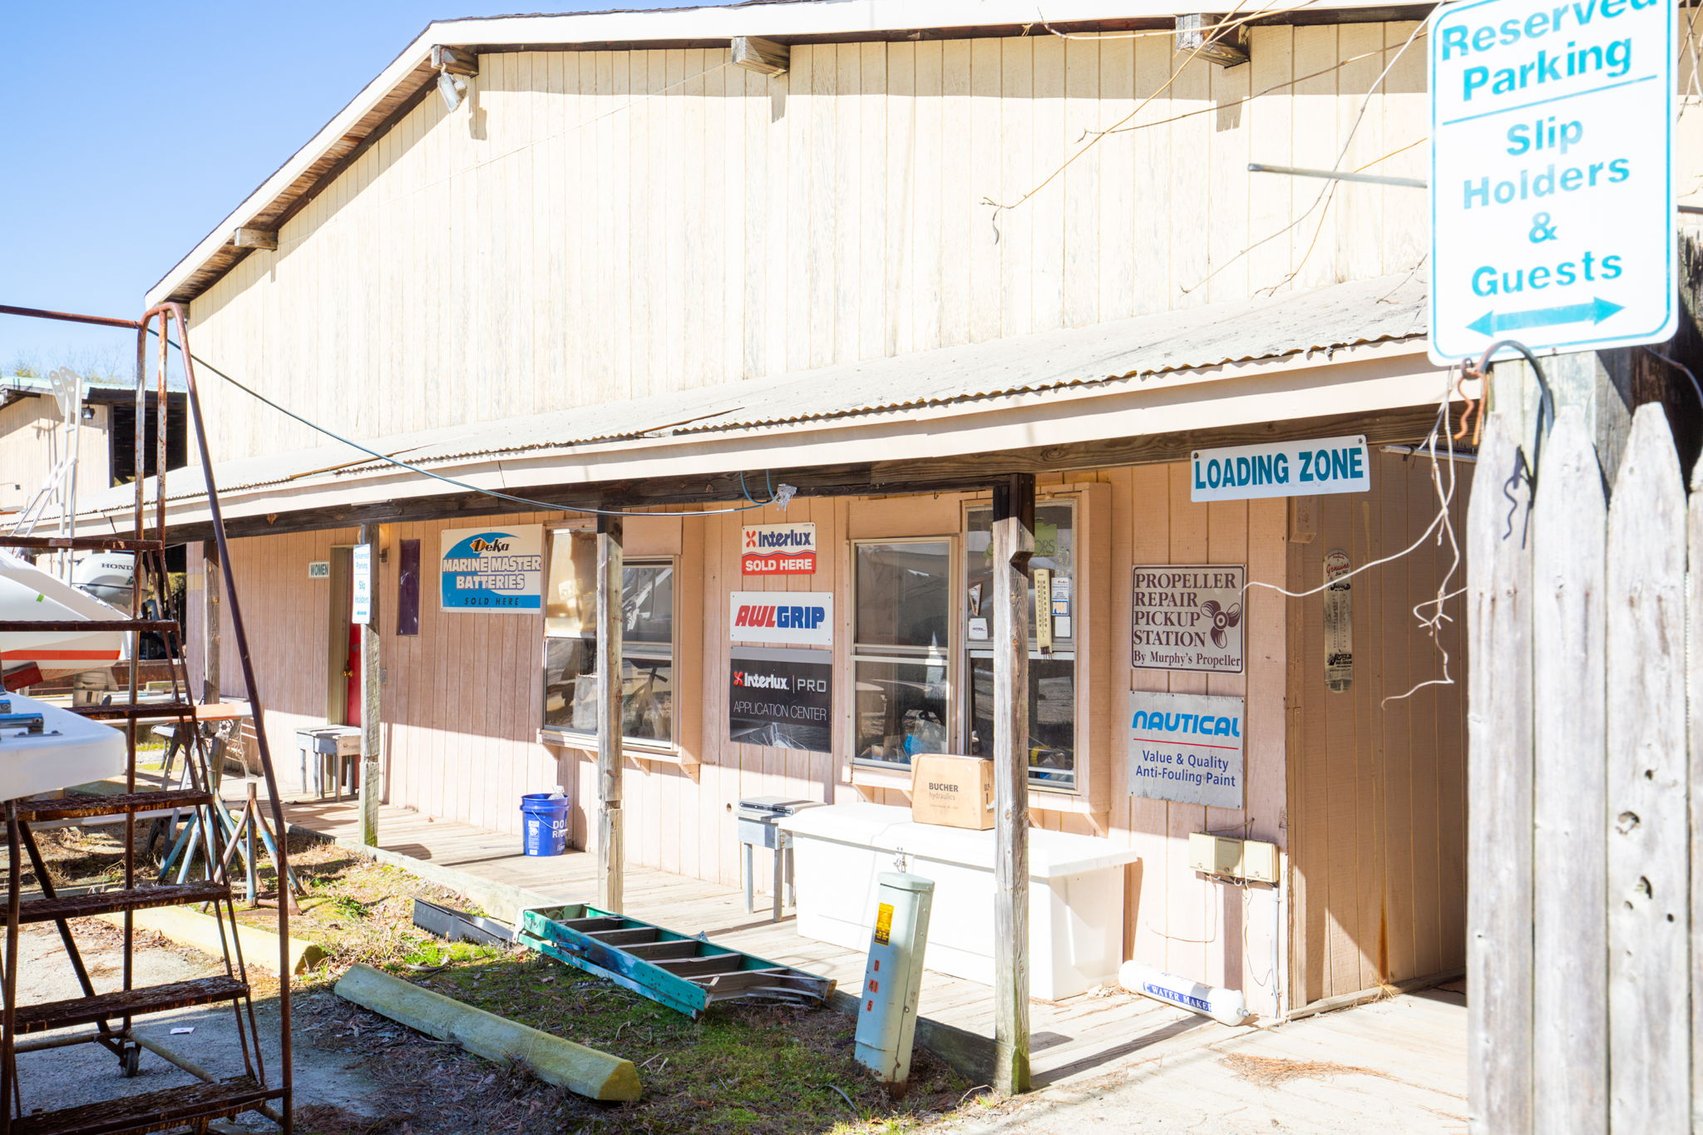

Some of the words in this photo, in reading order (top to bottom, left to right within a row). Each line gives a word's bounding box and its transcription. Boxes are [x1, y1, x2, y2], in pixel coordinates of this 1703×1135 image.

[1442, 0, 1658, 61] Reserve
[1463, 37, 1632, 102] Parking
[1506, 116, 1583, 156] Slip
[1463, 157, 1631, 209] Holders
[1528, 212, 1558, 244] &
[1471, 251, 1623, 297] Guests
[1195, 452, 1290, 490] LOADING
[1298, 447, 1364, 482] ZONE
[472, 538, 510, 553] Deka
[758, 529, 812, 547] Interlux
[101, 562, 134, 571] HOND
[310, 563, 329, 577] WOMEN
[442, 557, 488, 572] MARINE
[490, 555, 541, 573] MASTER
[745, 560, 777, 572] SOLD
[780, 559, 813, 570] HERE
[456, 574, 525, 590] BATTERIES
[1135, 572, 1237, 589] PROPELLER
[464, 596, 490, 606] SOLD
[495, 596, 520, 606] HERE
[1134, 591, 1198, 608] REPAIR
[734, 605, 825, 629] AWLGRIP
[1134, 610, 1201, 627] PICKUP
[1133, 629, 1207, 648] STATION
[1134, 650, 1146, 664] By
[1150, 650, 1193, 666] Murphy's
[1196, 653, 1240, 668] Propeller
[744, 672, 788, 690] Interlux
[797, 678, 827, 693] PRO
[733, 700, 789, 718] APPLICATION
[790, 705, 827, 720] CENTER
[1132, 710, 1240, 737] NAUTICAL
[1142, 750, 1173, 764] Value
[1176, 753, 1184, 765] &
[1187, 754, 1229, 772] Quality
[1136, 765, 1202, 786] Anti-Fouling
[1206, 772, 1236, 787] Paint
[928, 782, 959, 793] BUCHER
[1150, 985, 1180, 1002] WATER
